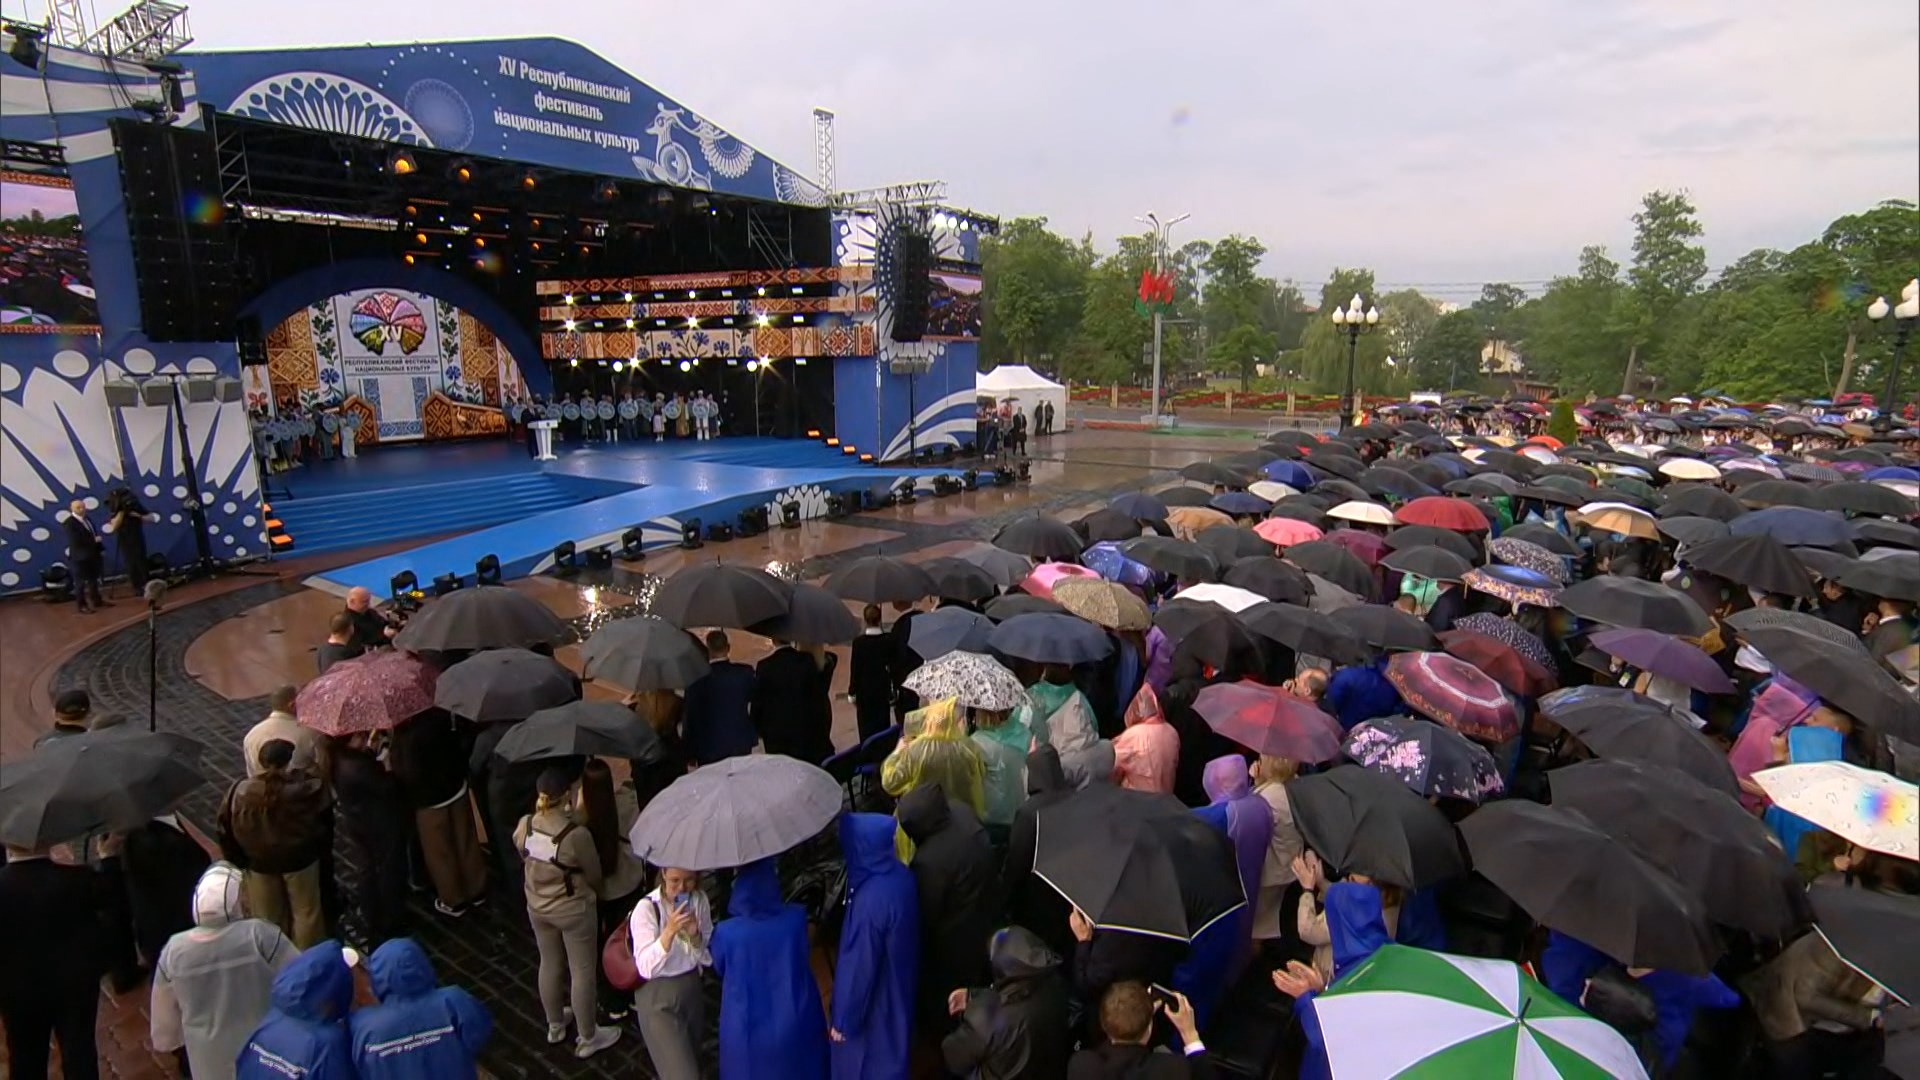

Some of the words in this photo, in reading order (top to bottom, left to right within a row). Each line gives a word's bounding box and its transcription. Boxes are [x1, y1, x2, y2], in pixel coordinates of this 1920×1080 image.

[498, 55, 516, 77] XV
[520, 60, 630, 104] Республиканский
[534, 90, 603, 121] фестиваль
[494, 110, 591, 142] национальных
[594, 130, 640, 153] культур
[379, 325, 402, 341] XV
